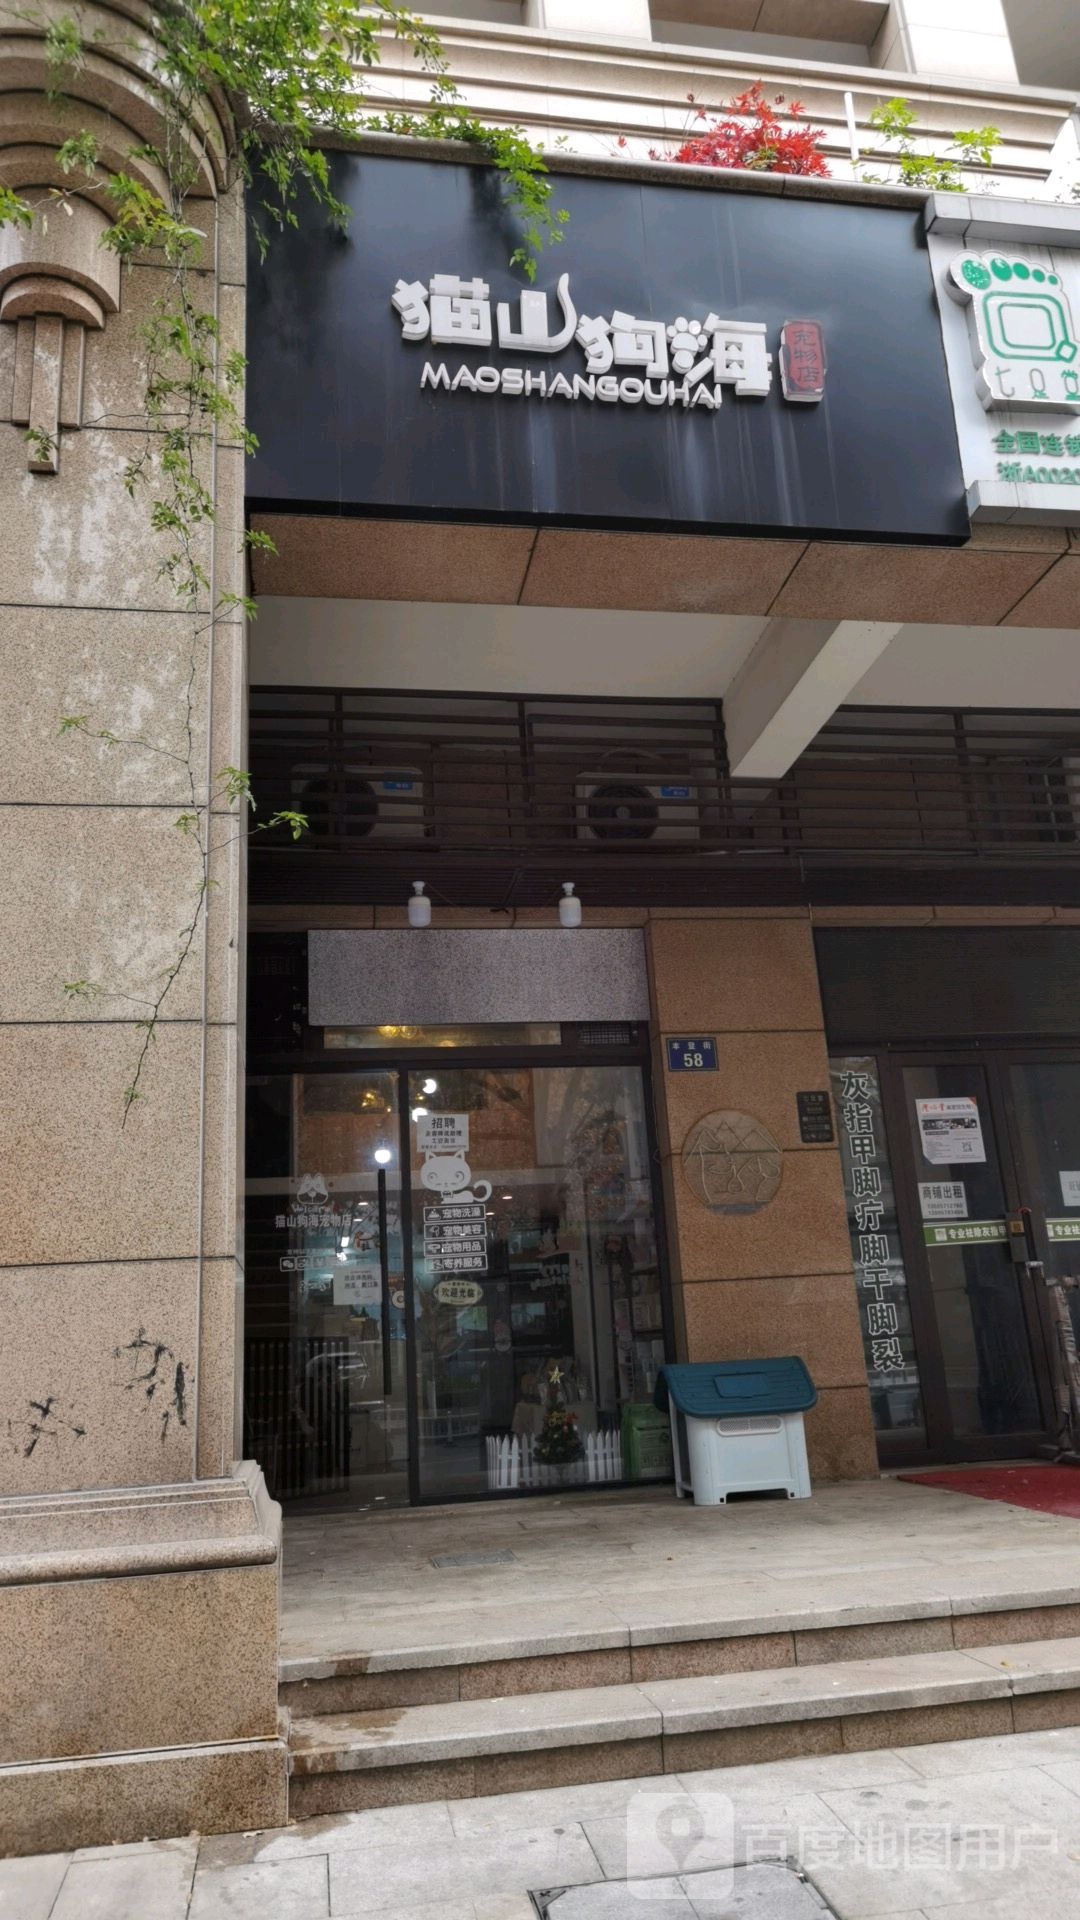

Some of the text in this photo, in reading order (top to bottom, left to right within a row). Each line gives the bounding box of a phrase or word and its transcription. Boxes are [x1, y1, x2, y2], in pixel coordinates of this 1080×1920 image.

[420, 361, 723, 410] MAOSHANGOUHAI
[683, 1052, 704, 1067] 58
[431, 1117, 456, 1130] 招聘
[922, 1185, 963, 1200] 商铺出租
[442, 1241, 482, 1253] 宠物用品
[441, 1287, 475, 1298] 欢迎光临
